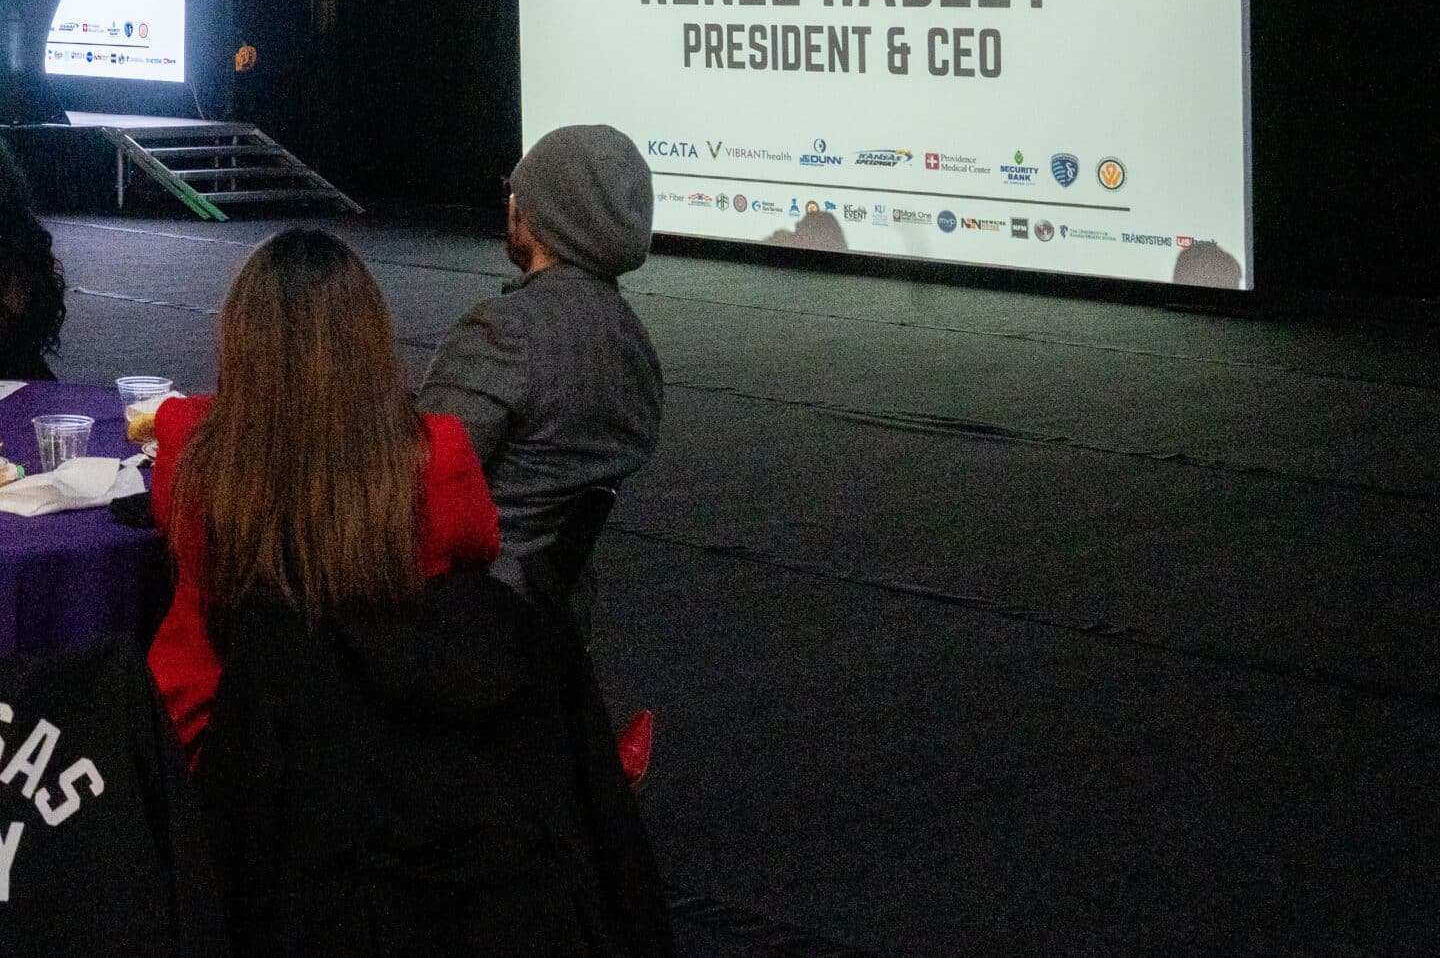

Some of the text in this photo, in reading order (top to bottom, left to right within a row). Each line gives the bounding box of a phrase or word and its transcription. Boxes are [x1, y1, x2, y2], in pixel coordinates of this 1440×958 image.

[683, 22, 1002, 78] PRESIDENT & CEO
[648, 140, 699, 159] KCATA
[940, 153, 977, 164] Providence
[940, 163, 992, 174] Medical Center
[1000, 165, 1039, 175] SECURITY
[1008, 173, 1031, 182] BANK
[669, 193, 685, 202] Fiber
[918, 211, 933, 220] One
[1121, 233, 1173, 247] TRANSYSTEMS
